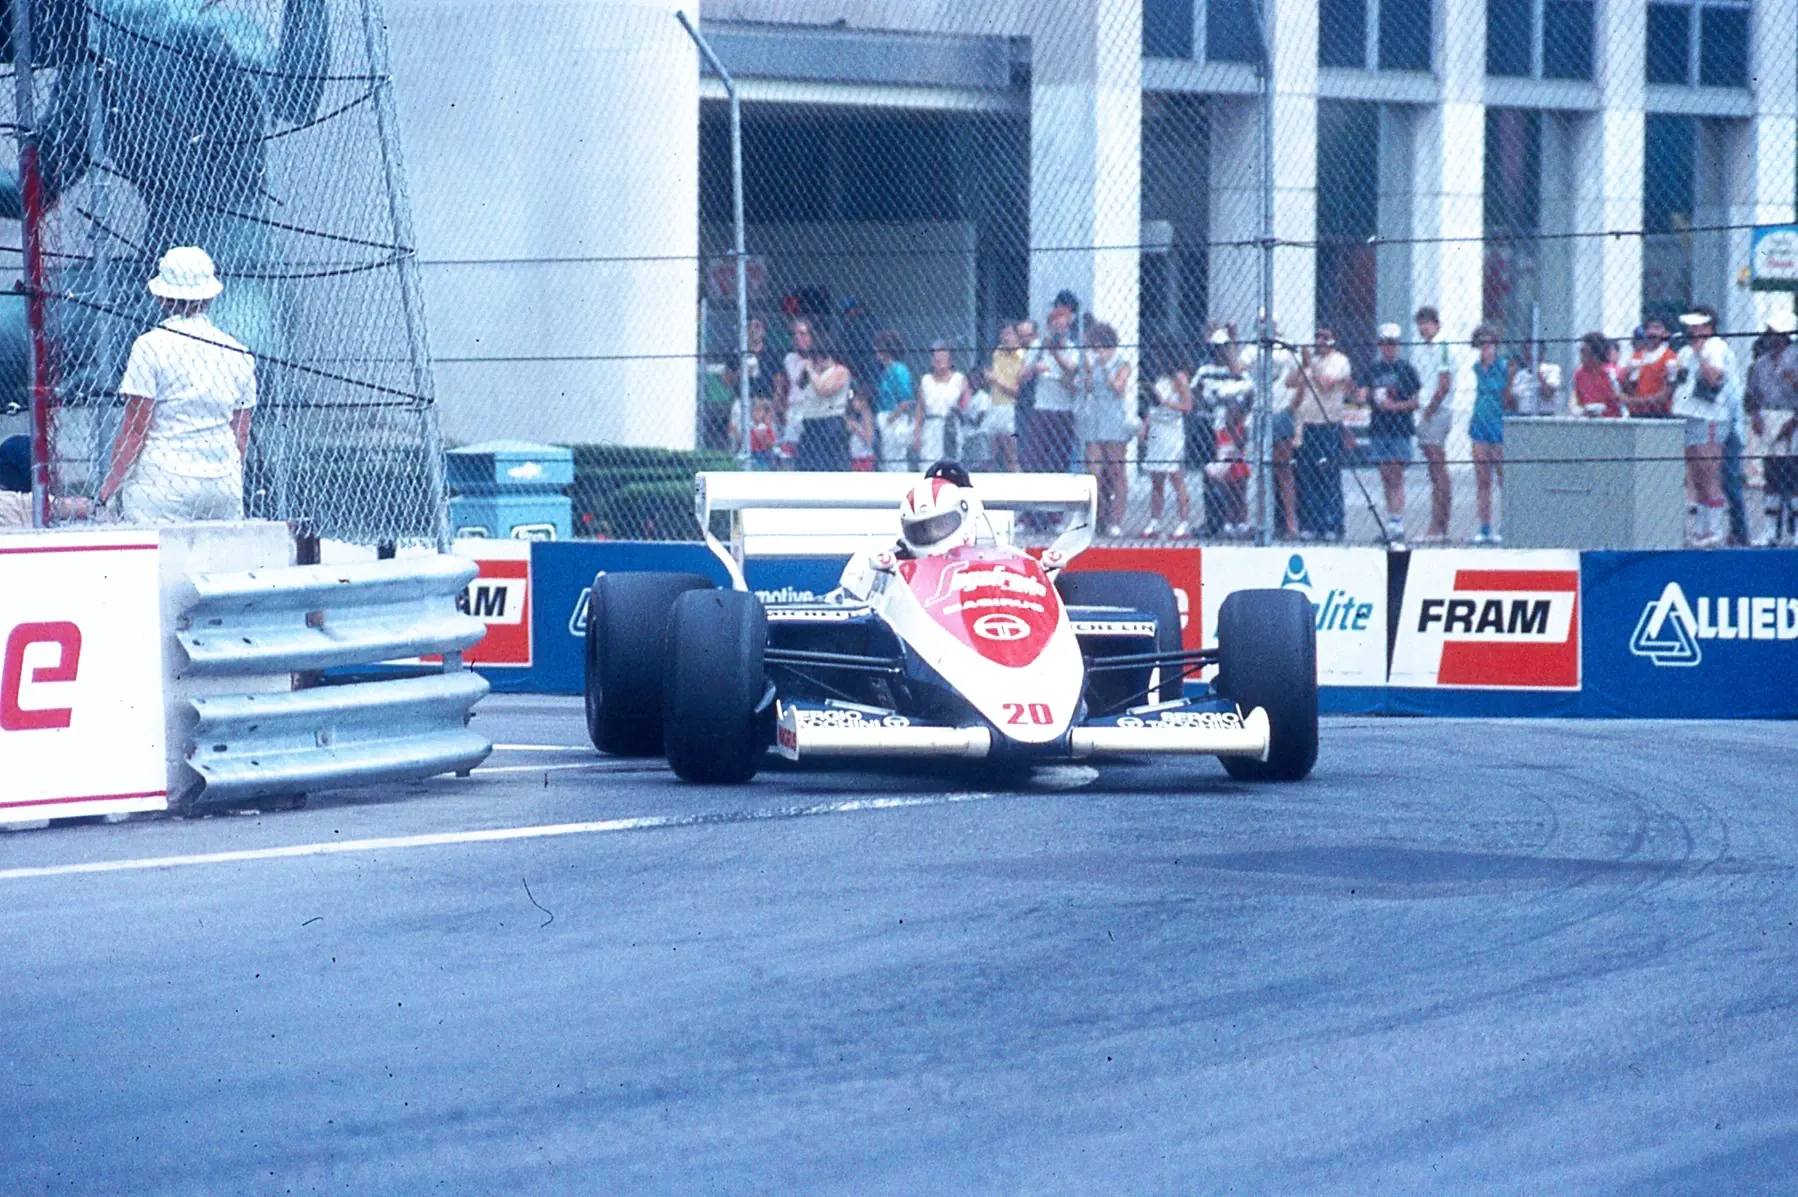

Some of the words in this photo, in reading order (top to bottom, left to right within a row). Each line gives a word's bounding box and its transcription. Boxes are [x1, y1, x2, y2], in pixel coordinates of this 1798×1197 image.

[455, 586, 508, 616] AM
[753, 585, 814, 602] motive
[1417, 598, 1552, 634] FRAM
[0, 621, 82, 731] e
[798, 710, 862, 721] ERGIO
[1002, 703, 1054, 725] 20
